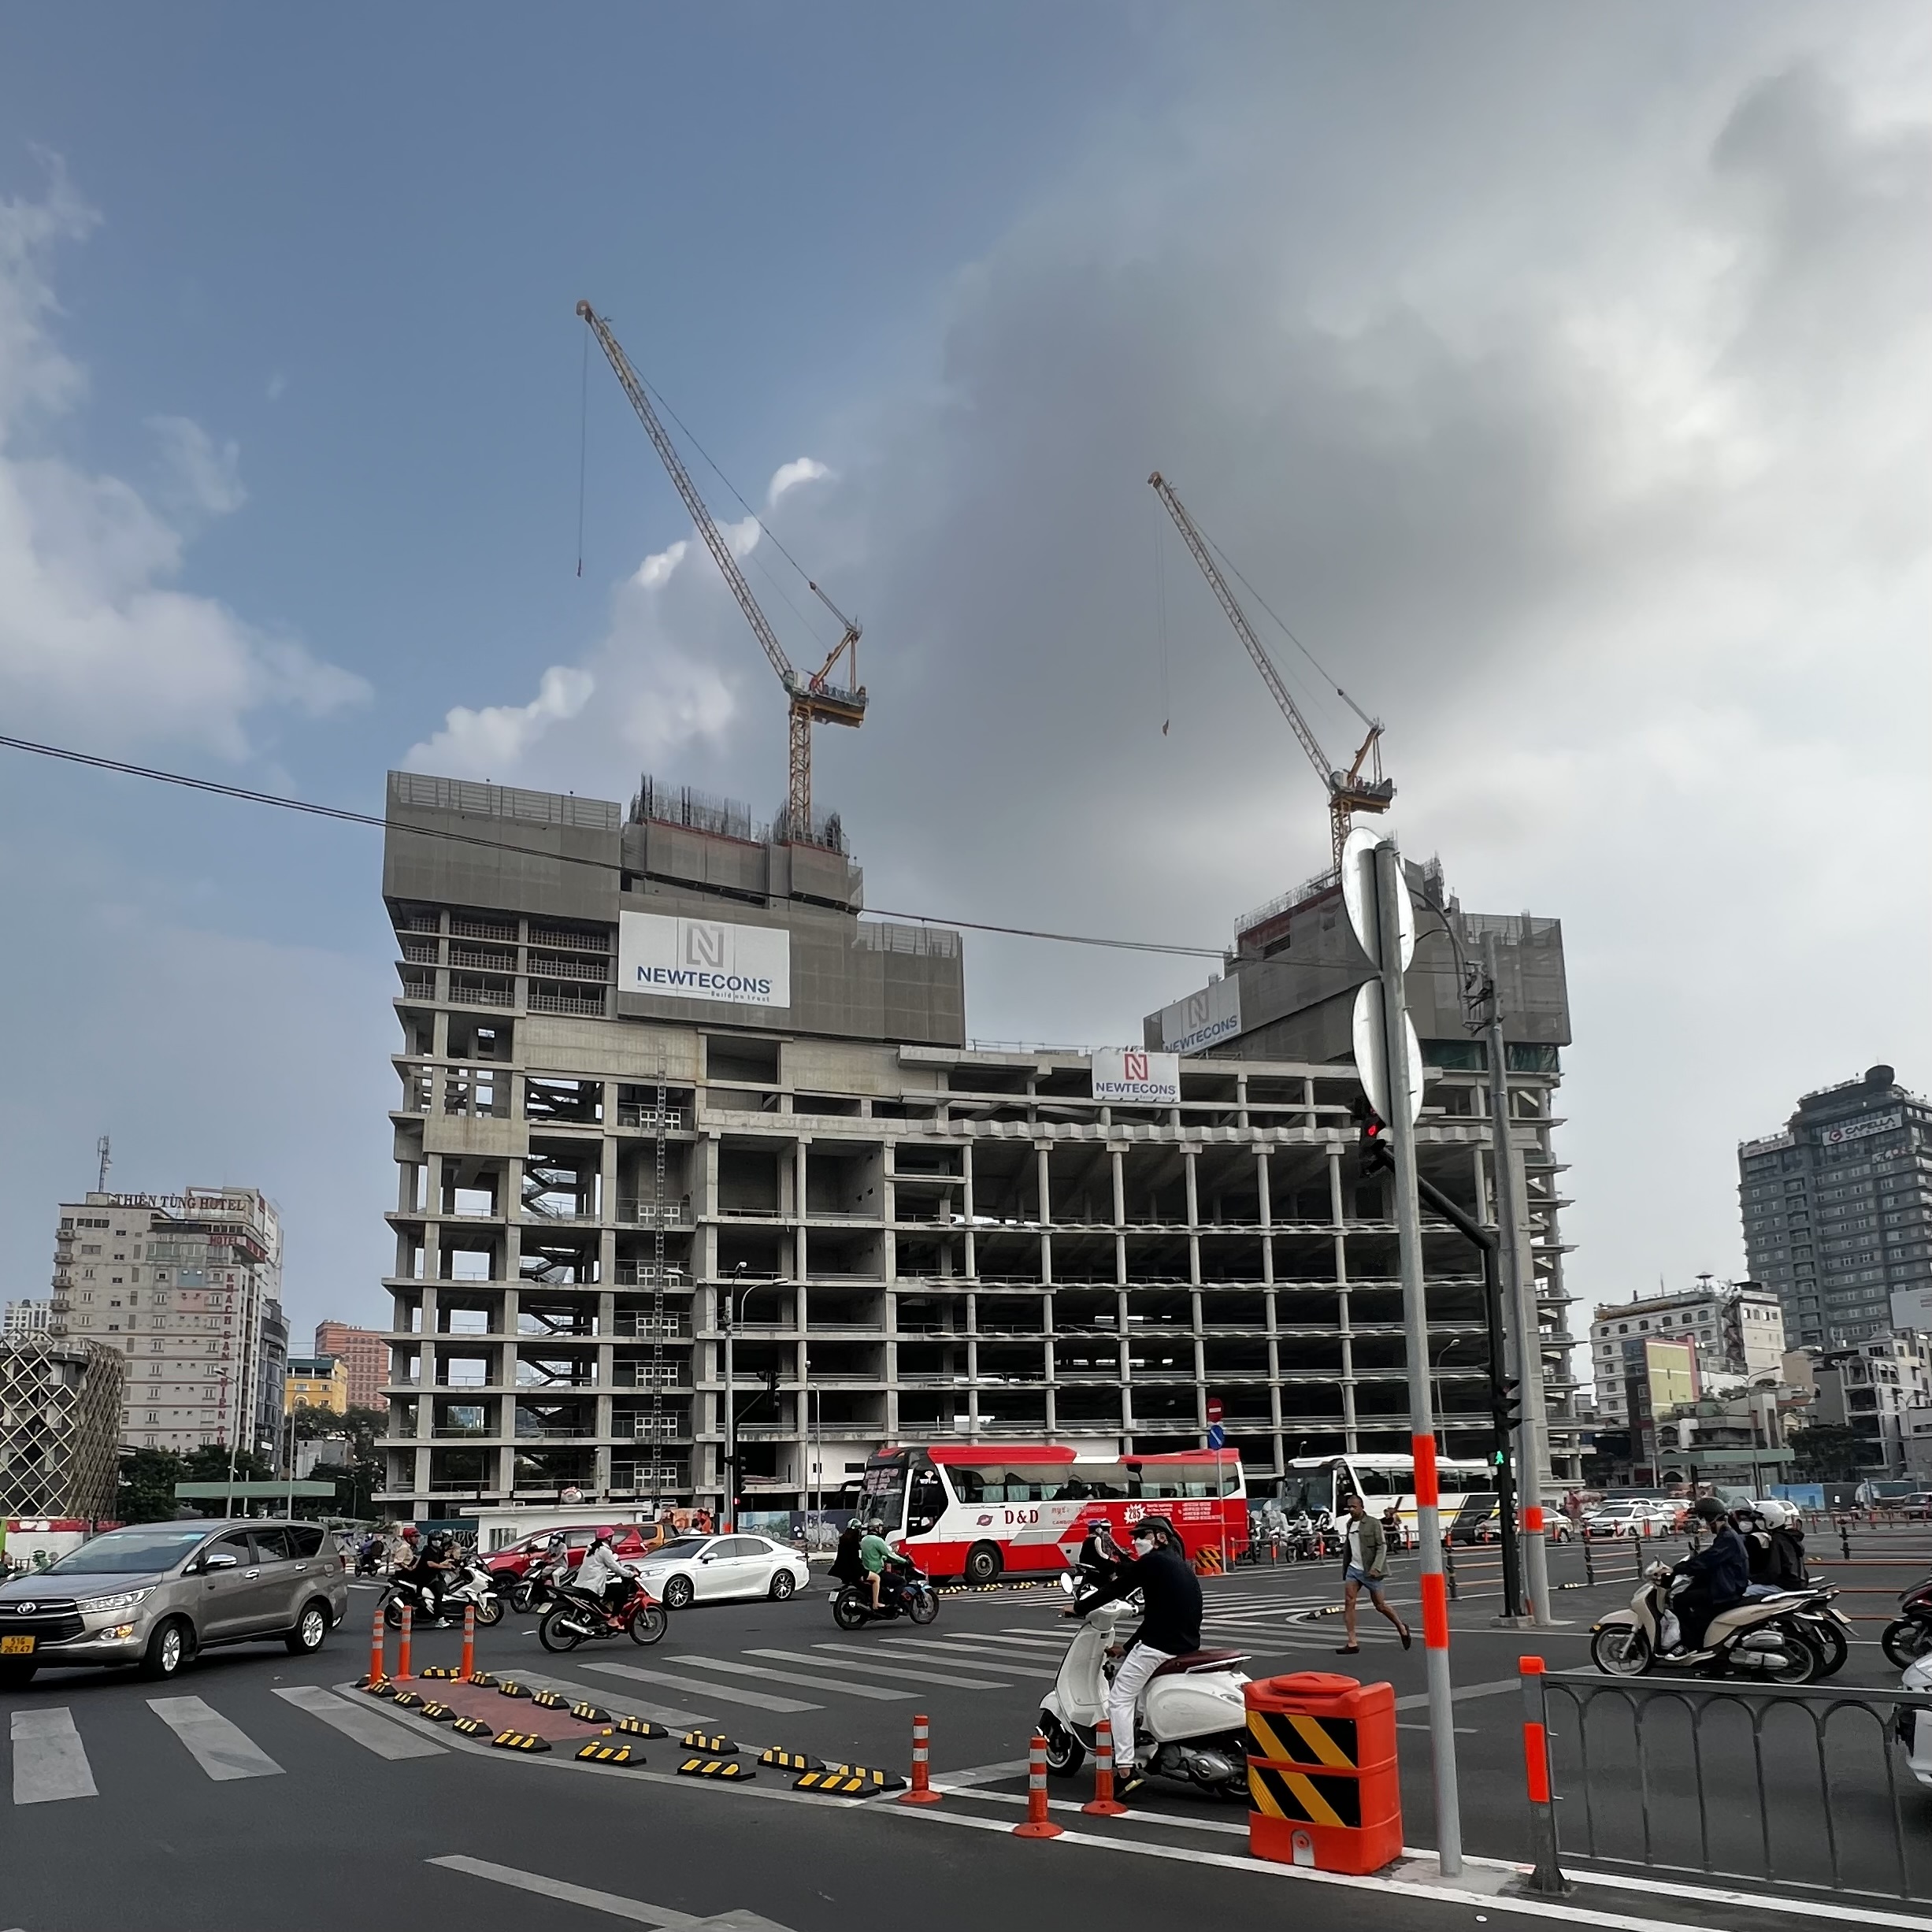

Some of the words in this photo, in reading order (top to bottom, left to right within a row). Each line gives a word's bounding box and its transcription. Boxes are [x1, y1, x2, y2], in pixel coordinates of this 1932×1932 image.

[636, 966, 771, 994] NEWTECONS
[1096, 1082, 1177, 1095] NEWTECONS
[1845, 1117, 1895, 1135] CAPELLA
[200, 1196, 245, 1211] HOTEL
[210, 1235, 238, 1246] HOTEL
